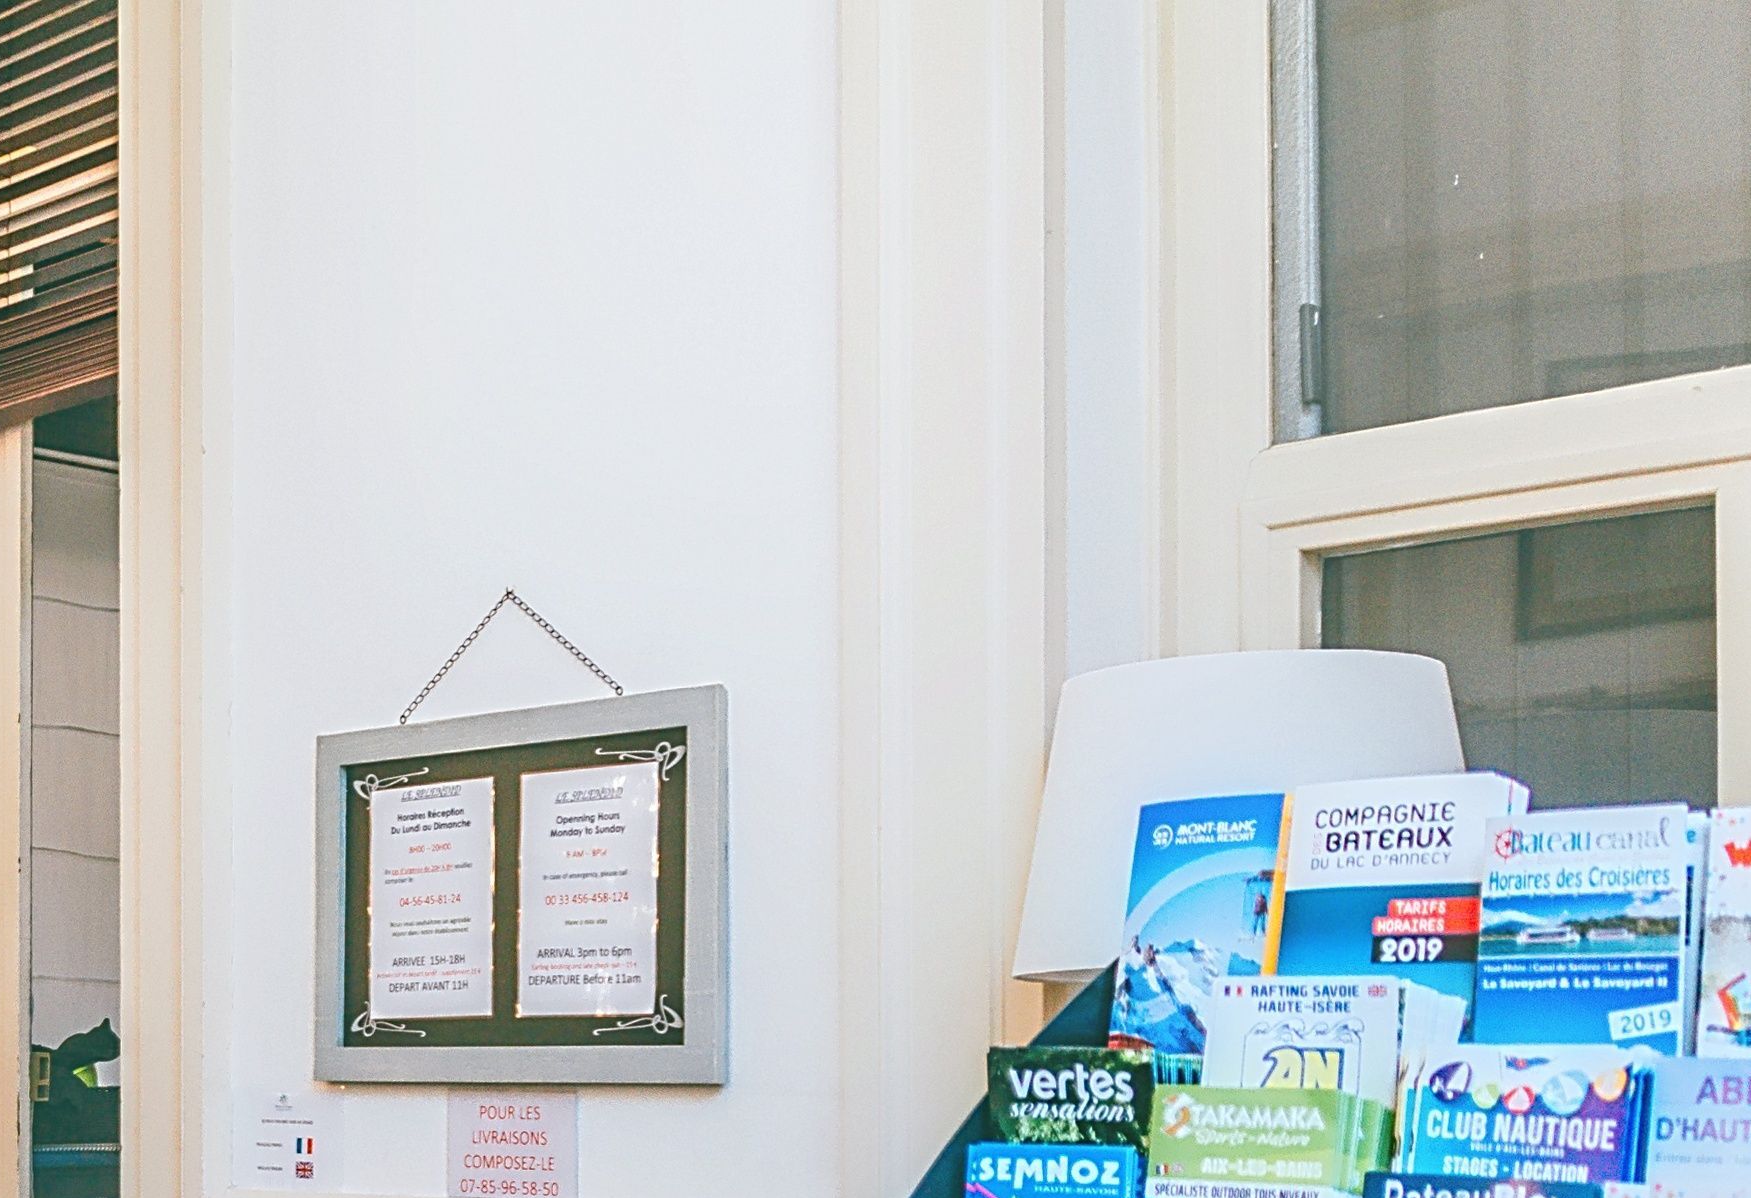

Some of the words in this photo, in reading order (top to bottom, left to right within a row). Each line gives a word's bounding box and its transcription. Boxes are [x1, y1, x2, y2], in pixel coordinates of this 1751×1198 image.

[397, 812, 426, 822] Horaires
[428, 807, 464, 820] Réception
[597, 812, 620, 821] Hours
[1315, 801, 1456, 829] COMPAGNIE
[391, 827, 400, 835] Du
[403, 824, 421, 834] Lundi
[434, 820, 471, 830] Dimanche
[550, 828, 583, 837] Monday
[585, 827, 593, 835] to
[595, 824, 626, 835] Sunday
[1177, 819, 1258, 836] MONT-BLANC
[1326, 826, 1454, 853] BATEAUX
[1310, 857, 1329, 871] DU
[1336, 855, 1365, 869] LAC
[1490, 870, 1550, 891] Horaires
[1556, 867, 1582, 889] des
[1589, 866, 1670, 887] Croisières
[1396, 900, 1447, 915] TARIFS
[1377, 918, 1445, 933] HORAIRES
[537, 947, 575, 959] ARRIVAL
[577, 947, 597, 959] 3pm
[600, 948, 610, 957] to
[611, 946, 632, 958] 6pm
[1380, 937, 1443, 962] 2019
[388, 981, 420, 993] DEPART
[421, 980, 450, 991] AVANT
[452, 980, 469, 990] 11H
[528, 974, 581, 986] DEPARTURE
[583, 974, 613, 984] Before
[616, 973, 642, 984] 11am
[1500, 978, 1556, 991] Savoyard
[1593, 976, 1654, 991] Savoyard
[1251, 985, 1308, 998] RAFTING
[1313, 985, 1360, 998] SAVOIE
[1620, 1009, 1672, 1034] 2019
[1008, 1063, 1134, 1102] vertes
[479, 1105, 515, 1121] POUR
[520, 1105, 541, 1121] LES
[1009, 1098, 1135, 1124] sensations
[1193, 1104, 1326, 1130] TAKAMAKA
[1426, 1109, 1487, 1142] CLUB
[1493, 1112, 1617, 1151] NAUTIQUE
[472, 1130, 548, 1147] LIVRAISONS
[463, 1154, 555, 1172] COMPOSEZ-LE
[1443, 1155, 1498, 1178] STAGES
[1513, 1160, 1589, 1183] LOCATION
[979, 1154, 1120, 1190] SEMNOZ
[460, 1179, 559, 1198] 07-85-96-58-50
[1034, 1185, 1119, 1196] HAUTE-SAVOIE
[1154, 1183, 1208, 1198] SPÉCIALISTE
[1211, 1186, 1251, 1198] OUTDOOR
